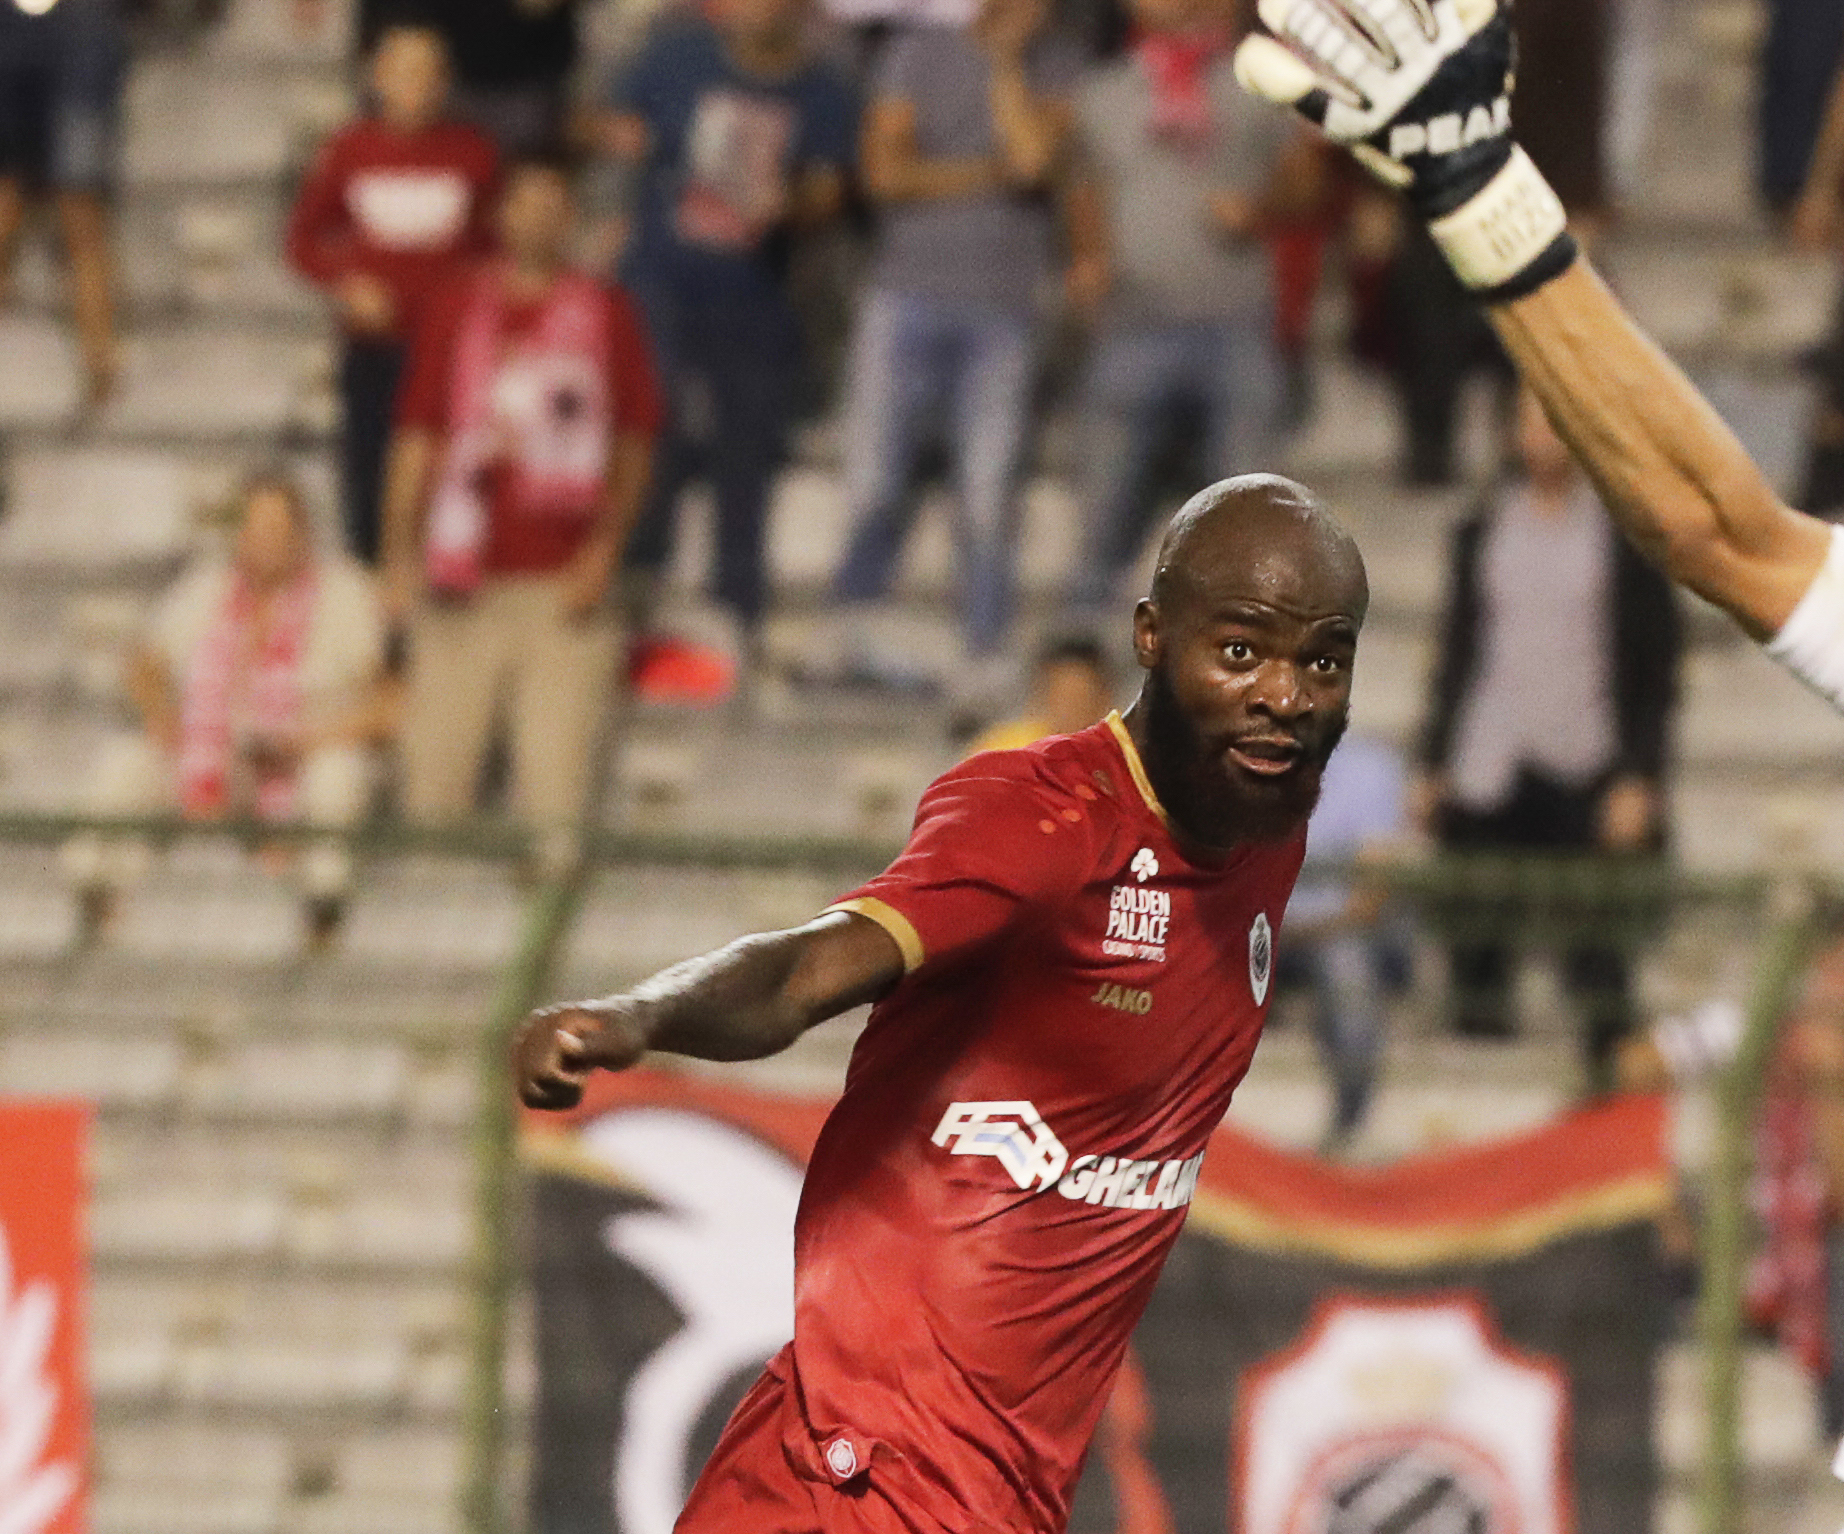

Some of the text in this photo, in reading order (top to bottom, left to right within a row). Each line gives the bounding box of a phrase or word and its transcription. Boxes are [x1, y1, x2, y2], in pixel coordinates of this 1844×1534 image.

[1110, 886, 1171, 916] GOLDEN
[1105, 910, 1169, 944] PALACE
[1091, 982, 1153, 1015] JAKO
